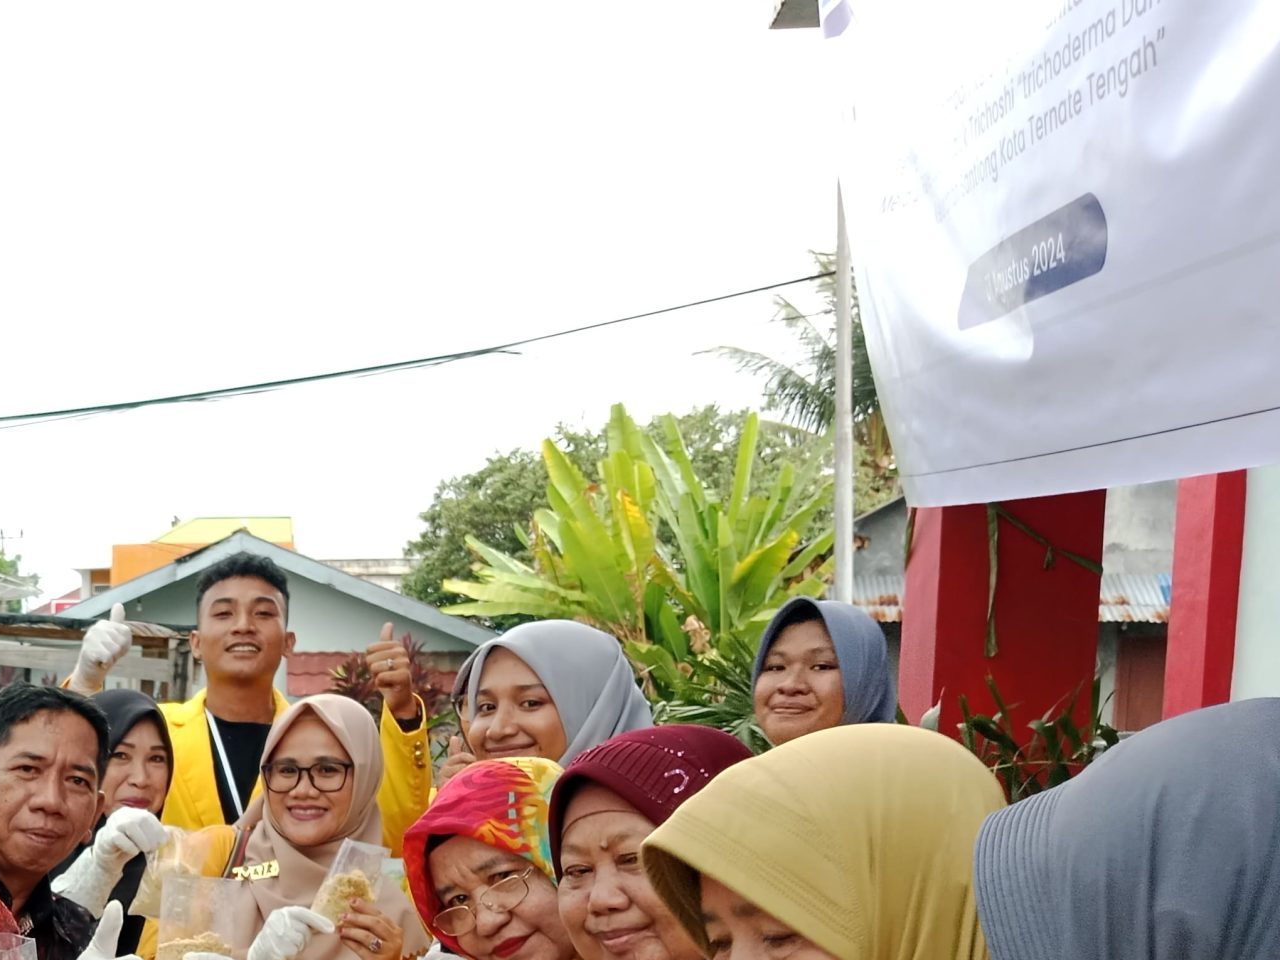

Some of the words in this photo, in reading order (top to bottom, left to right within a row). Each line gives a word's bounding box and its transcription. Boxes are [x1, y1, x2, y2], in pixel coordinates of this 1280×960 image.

[998, 126, 1026, 168] Kota
[1027, 86, 1083, 146] Ternate
[1030, 231, 1066, 275] 2024
